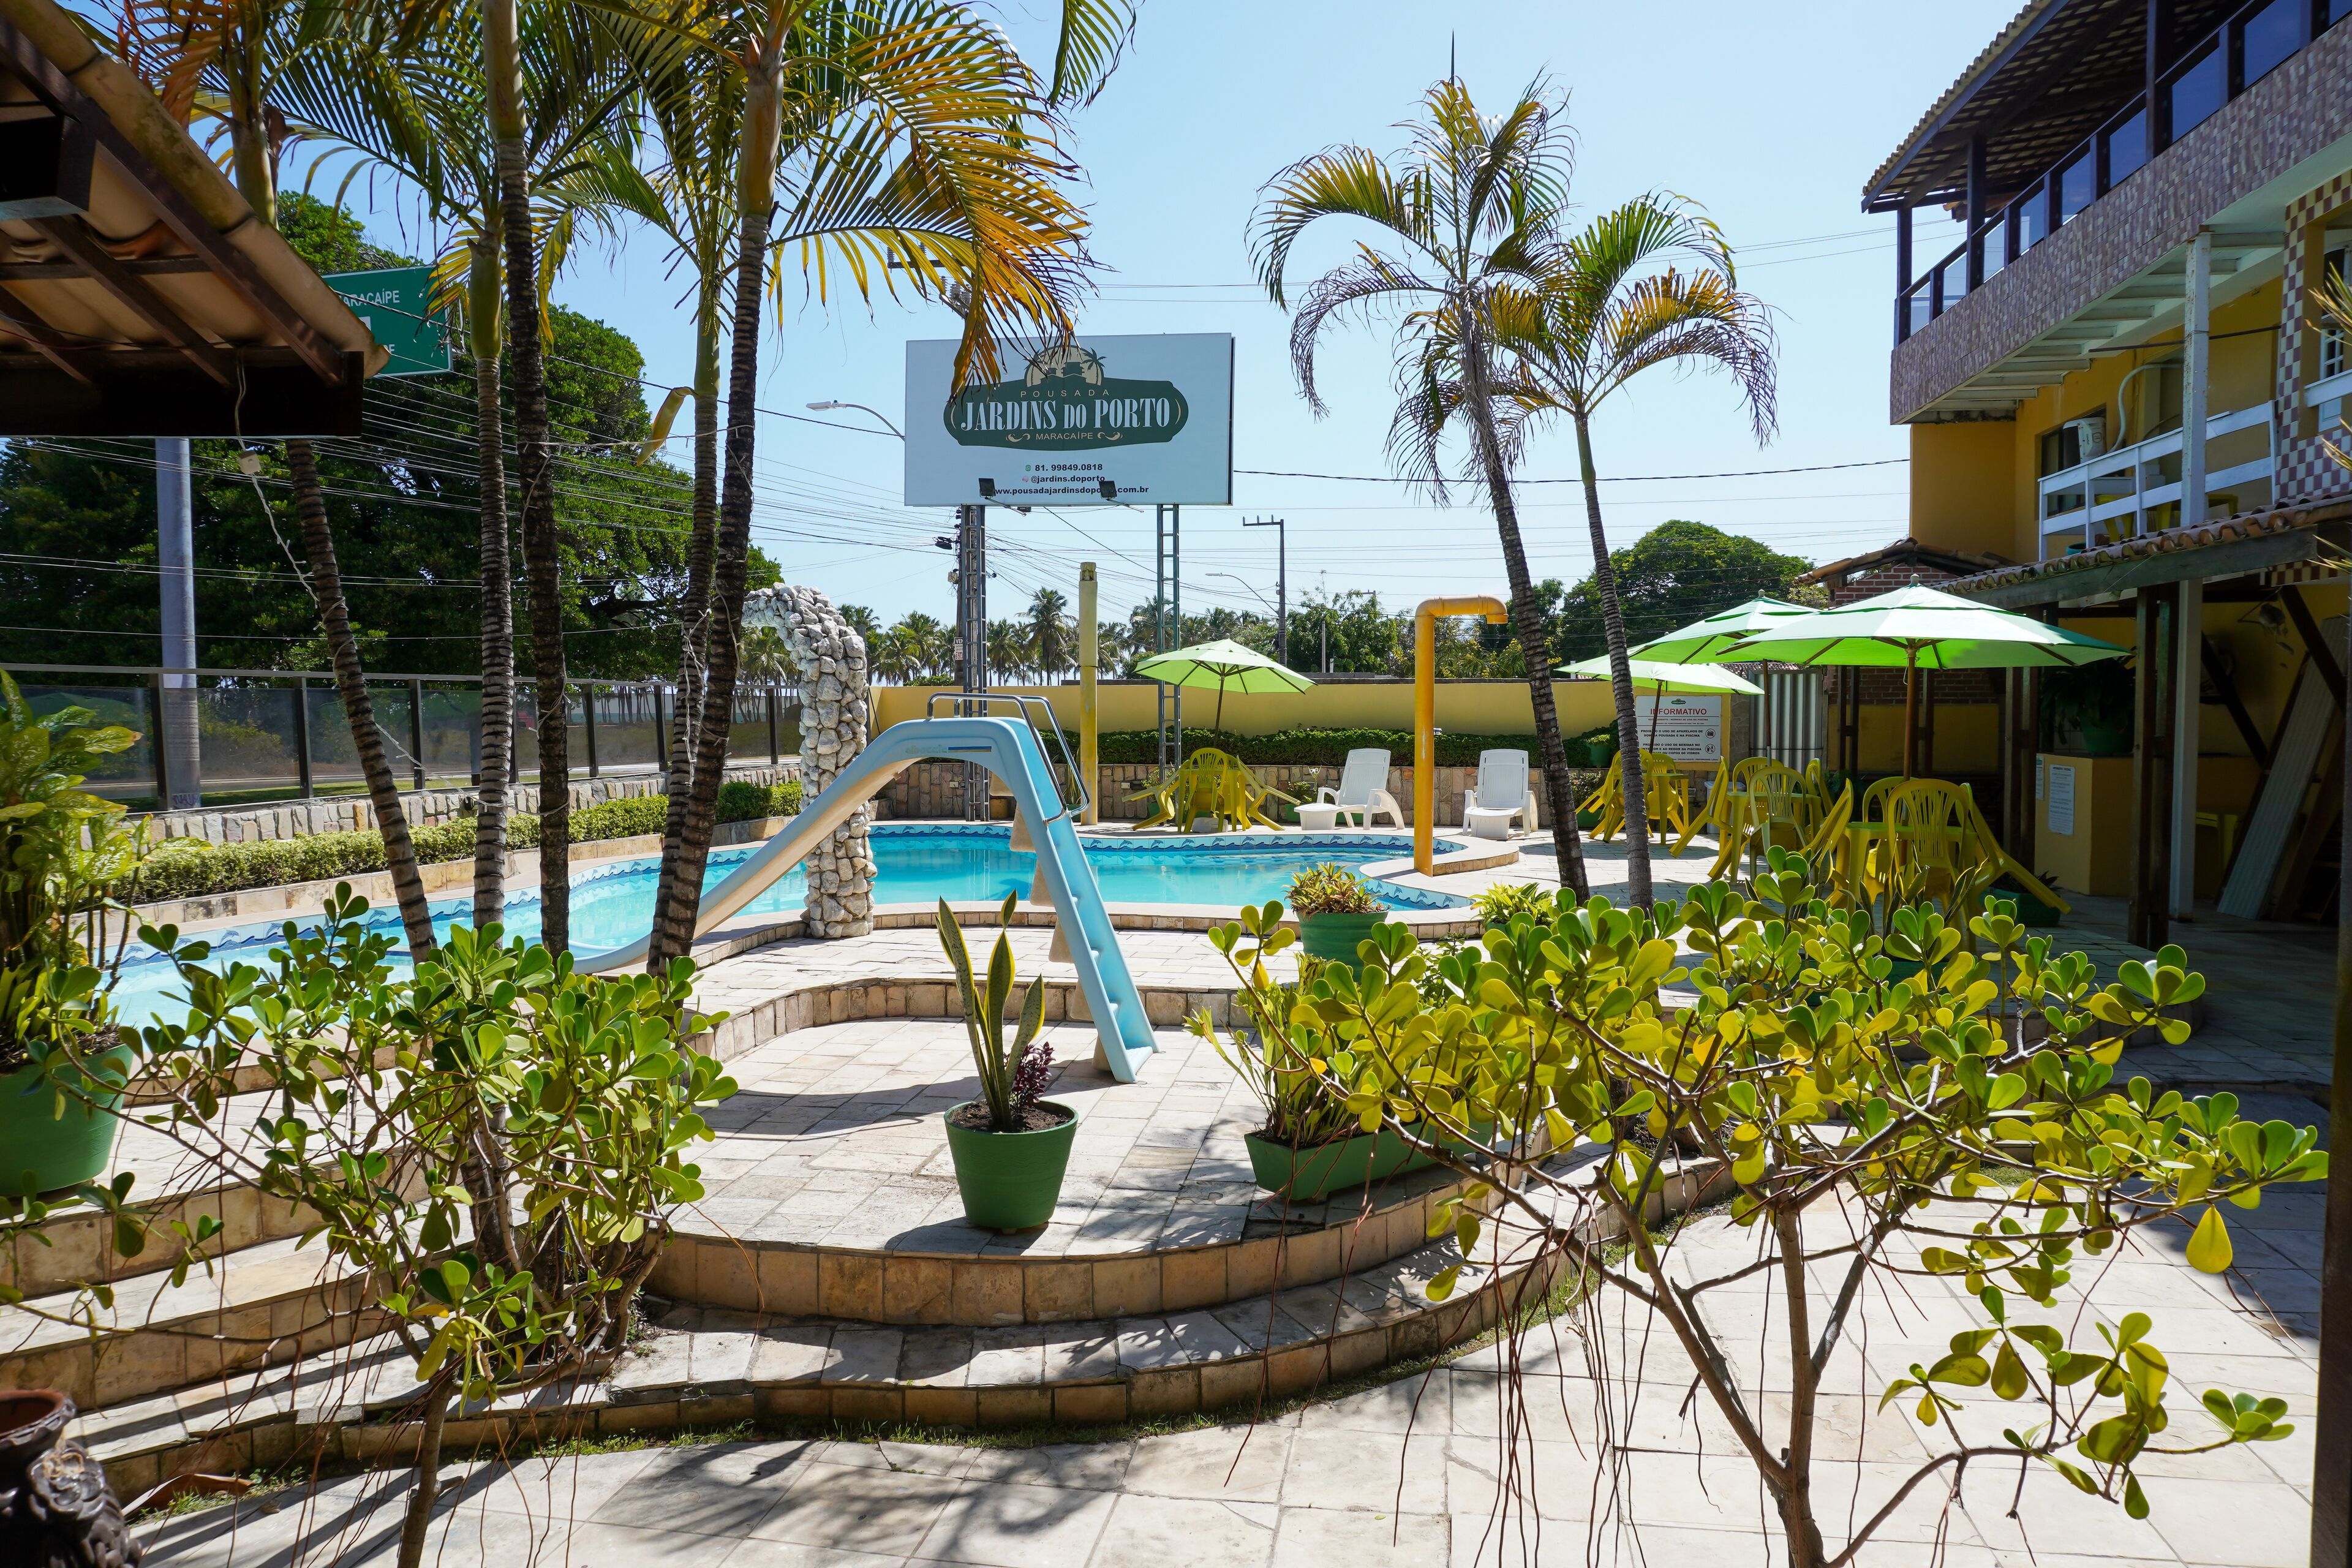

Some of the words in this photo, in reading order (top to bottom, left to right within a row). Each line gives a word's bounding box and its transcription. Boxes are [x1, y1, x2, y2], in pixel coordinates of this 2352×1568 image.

[339, 288, 400, 307] ARACAÍPE
[1020, 389, 1110, 398] POUSADA
[960, 400, 1056, 431] JARDINS
[1063, 404, 1087, 429] DO
[1094, 398, 1170, 428] PORTO
[1036, 431, 1093, 440] MARACAÍPE
[995, 486, 1149, 496] ww.pousadajardinsdopo.com.br
